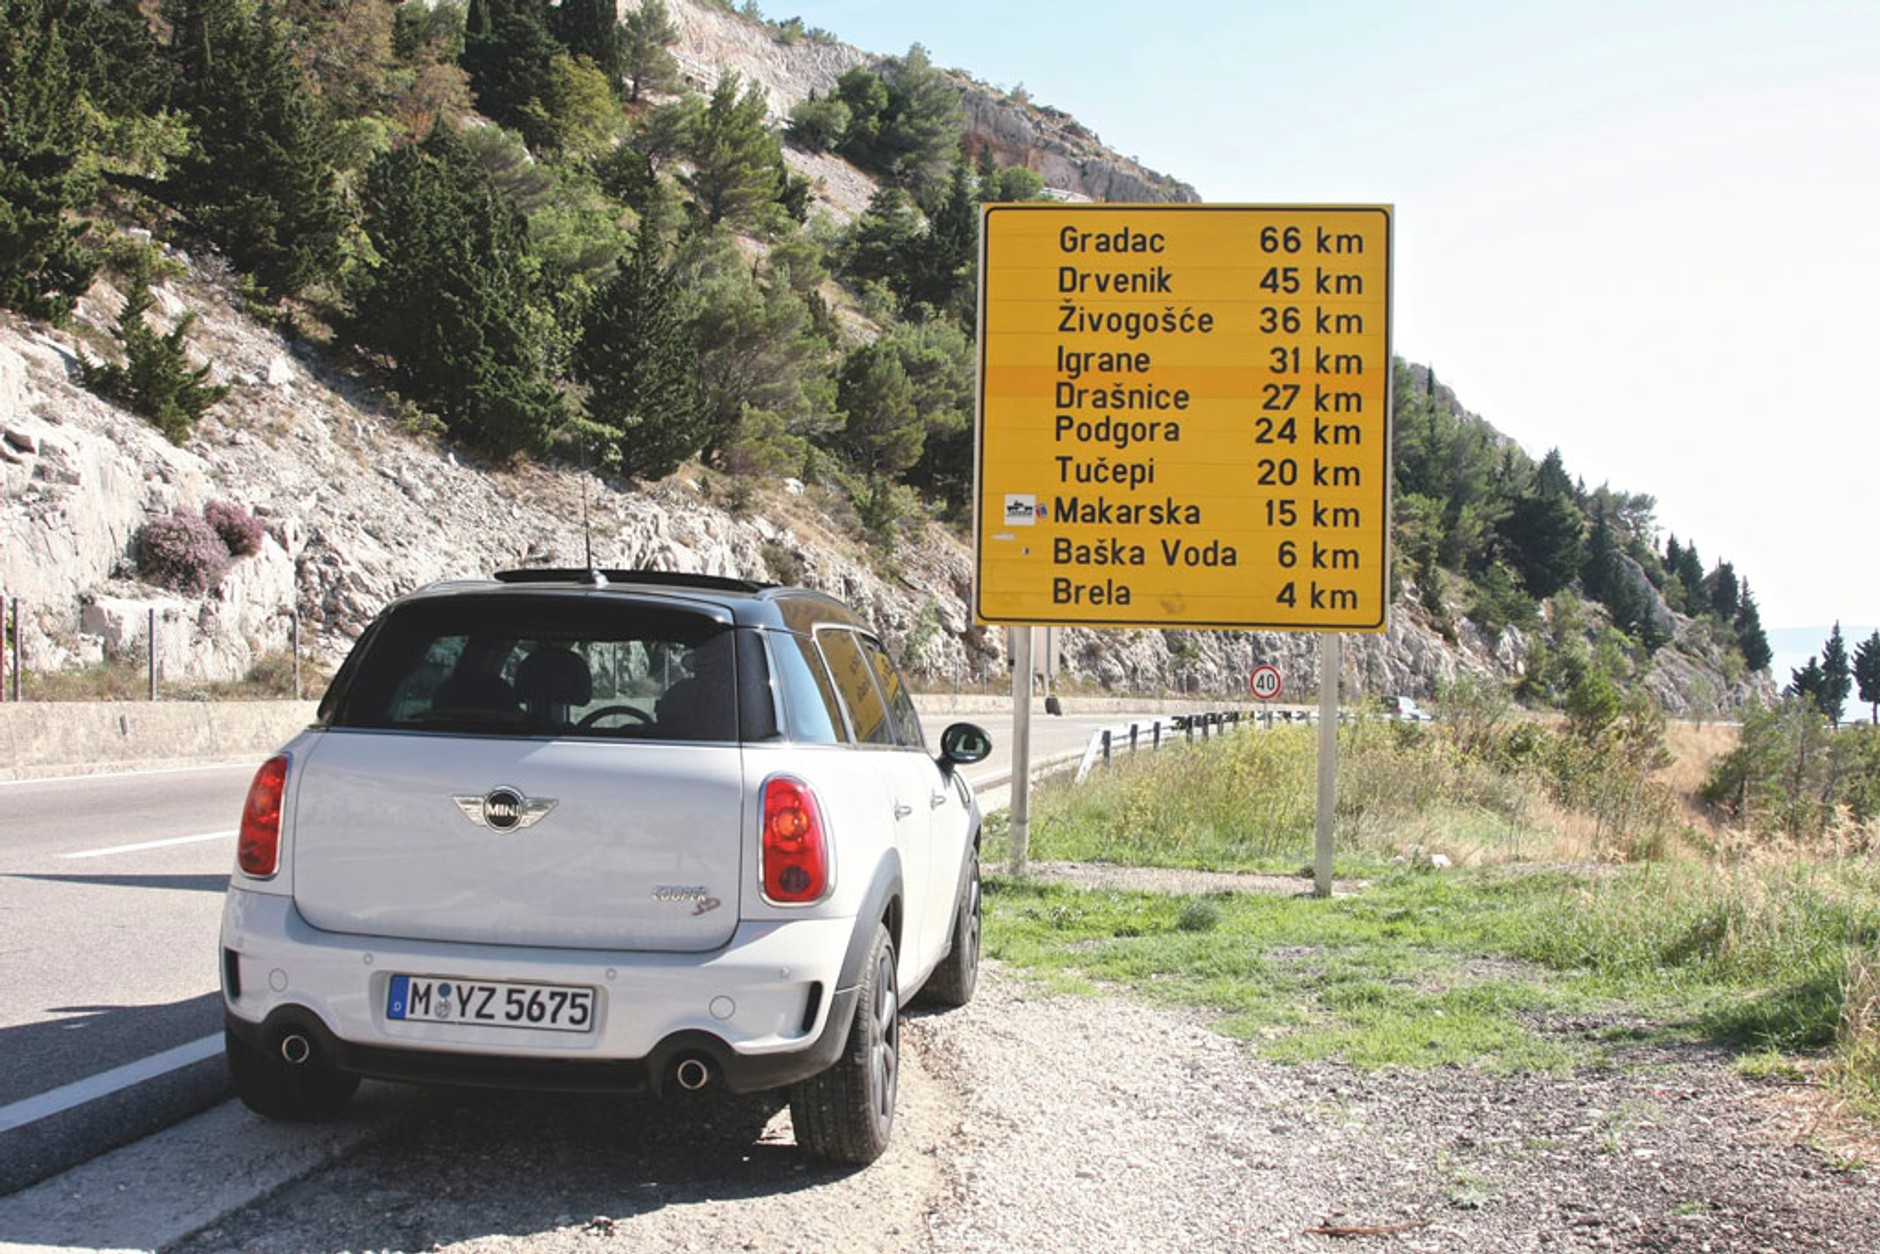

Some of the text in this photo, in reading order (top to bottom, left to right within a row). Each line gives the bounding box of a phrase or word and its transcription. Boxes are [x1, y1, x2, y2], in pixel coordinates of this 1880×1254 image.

[1059, 226, 1364, 254] Gradac 66 km
[1058, 266, 1363, 294] Drvenik 45 km
[1058, 298, 1363, 339] Živogošće 36 km
[1057, 345, 1363, 380] Igrane 31 km
[1055, 382, 1362, 412] Drašnice 27 km
[1055, 415, 1361, 449] Podgora 24 km
[1055, 456, 1361, 490] Tučepi 20 km
[1054, 496, 1360, 528] Makarska 15 km
[1053, 537, 1360, 569] Baška Voda 6 km
[1053, 577, 1358, 610] Brela 4 km
[1256, 673, 1276, 691] 40
[488, 803, 520, 817] MINI
[409, 981, 590, 1026] M YZ 5675
